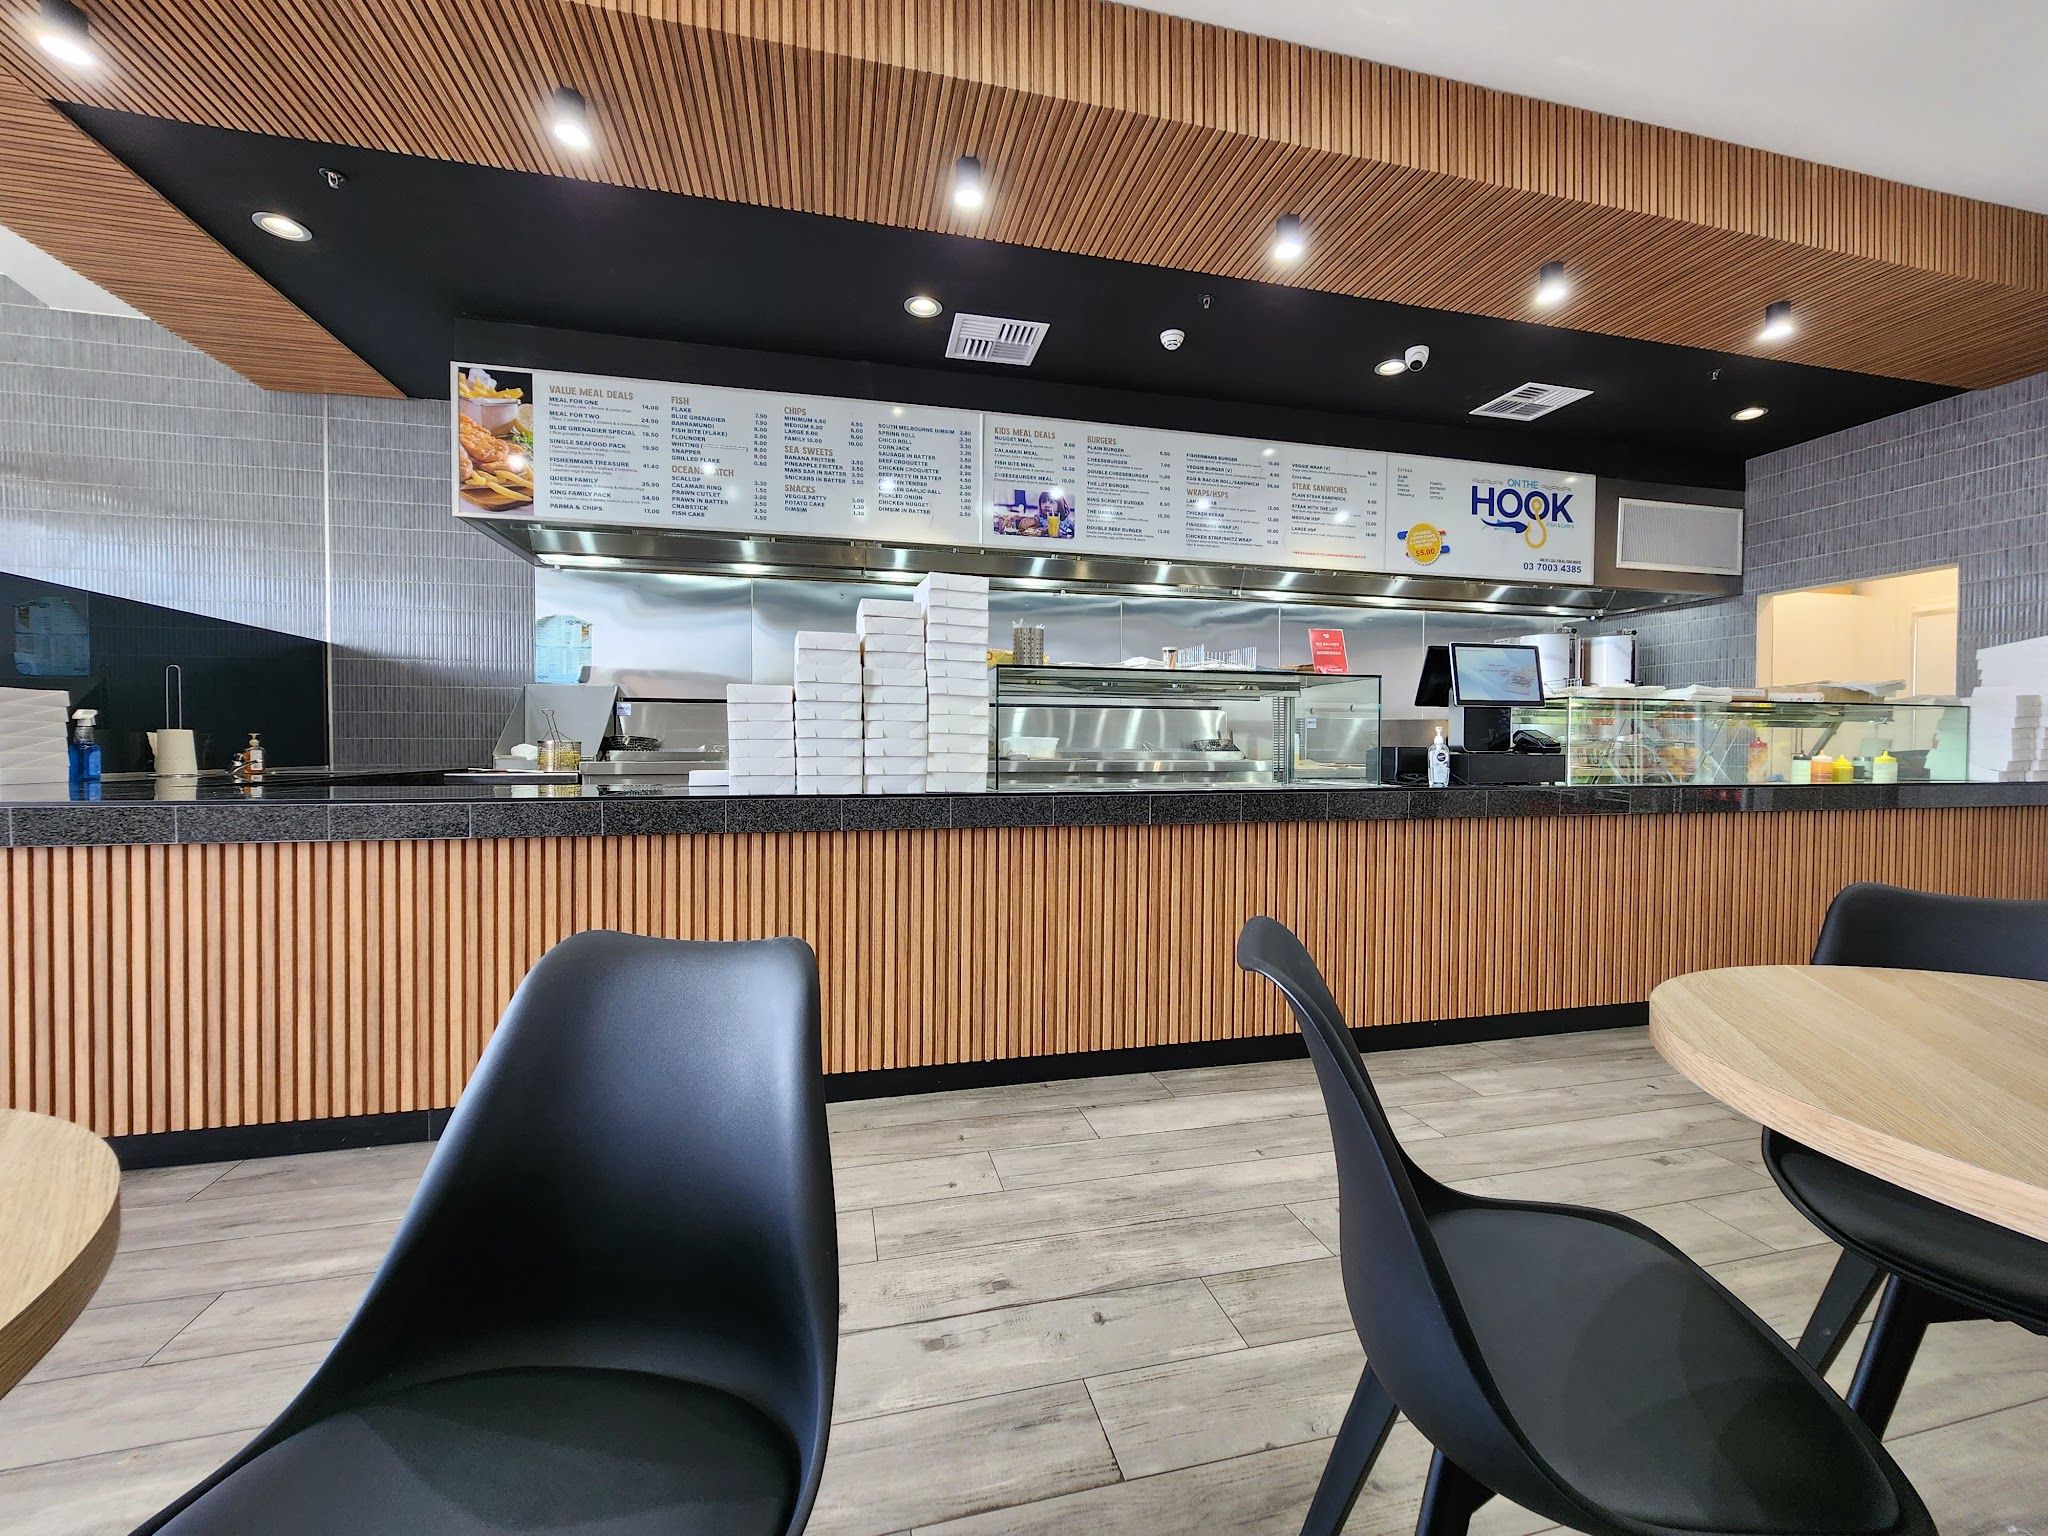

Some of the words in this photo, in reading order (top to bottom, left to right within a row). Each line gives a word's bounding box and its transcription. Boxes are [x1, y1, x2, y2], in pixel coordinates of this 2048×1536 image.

[549, 385, 576, 395] VALUE
[579, 387, 604, 397] MEAL
[607, 390, 633, 400] DEALS
[671, 396, 689, 405] FISH
[784, 406, 807, 416] CHIPS
[689, 415, 726, 423] GRENADIER
[671, 420, 715, 429] BARRAMUNDI
[898, 425, 933, 433] MELBOURNE
[568, 426, 607, 434] GRENADIER
[994, 427, 1010, 435] KIDS
[1012, 428, 1032, 437] MEAL
[1034, 430, 1056, 439] DEALS
[672, 434, 706, 442] FLOUNDER
[1087, 435, 1117, 446] BURGERS
[575, 440, 608, 448] SEAFOOD
[784, 445, 799, 454] SEA
[802, 446, 833, 457] SWEETS
[550, 457, 594, 465] FISHERMANS
[784, 461, 817, 469] PINEAPPLE
[893, 459, 928, 467] CROQUETTE
[1087, 457, 1128, 465] CHEESEBURGER
[709, 468, 734, 477] ATCH
[1292, 482, 1311, 491] STEAK
[1313, 484, 1347, 494] SANWICHES
[1507, 478, 1523, 488] ON
[1524, 480, 1538, 489] THE
[784, 484, 816, 494] SNACKS
[1186, 488, 1229, 499] WRAPS/HSPS
[671, 503, 709, 511] CRABSTICK
[1471, 485, 1574, 523] HOOK
[1416, 548, 1435, 557] $5.00
[1523, 562, 1534, 570] 03
[1537, 563, 1558, 572] 7003
[1561, 565, 1581, 573] 4385
